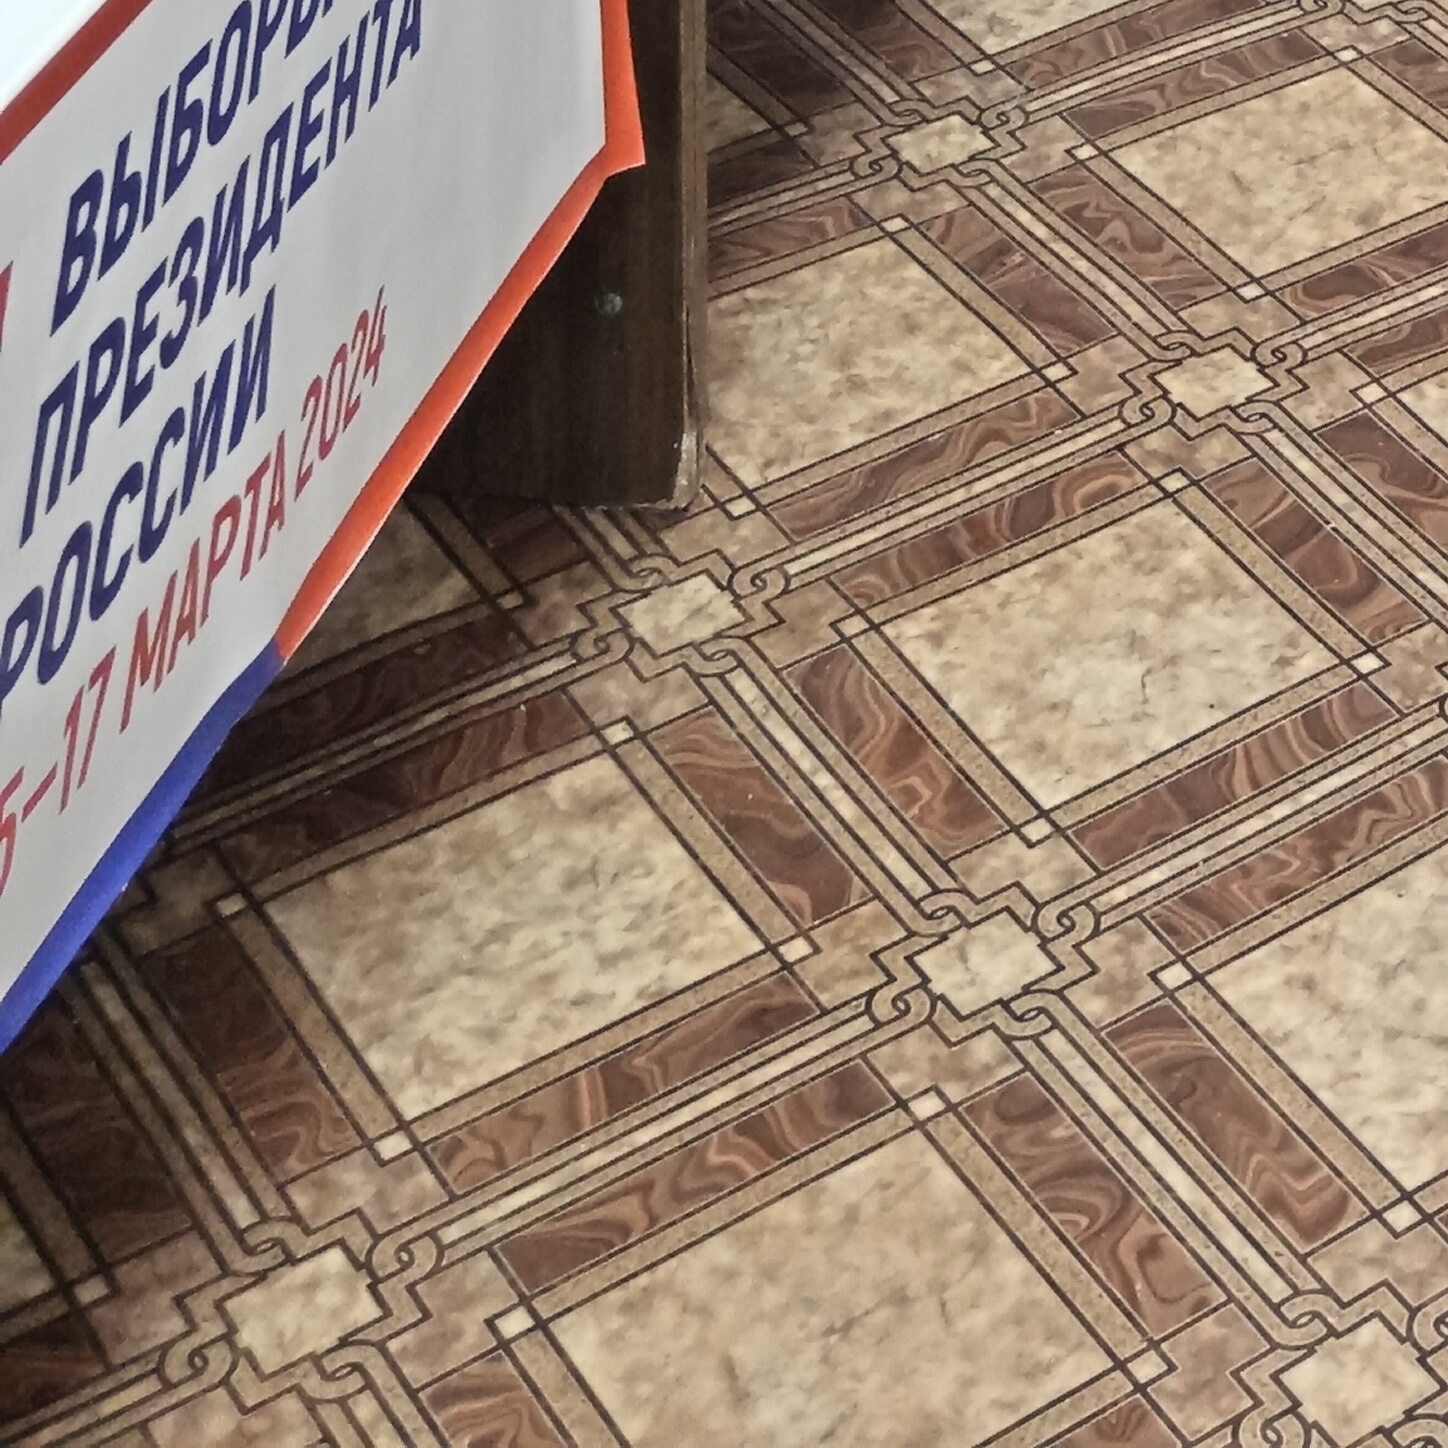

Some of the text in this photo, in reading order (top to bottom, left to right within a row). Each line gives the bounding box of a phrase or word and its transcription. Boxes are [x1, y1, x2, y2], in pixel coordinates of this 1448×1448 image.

[0, 283, 276, 720] РОССИИ
[119, 429, 287, 735] МАРТА
[294, 283, 388, 502] 2024
